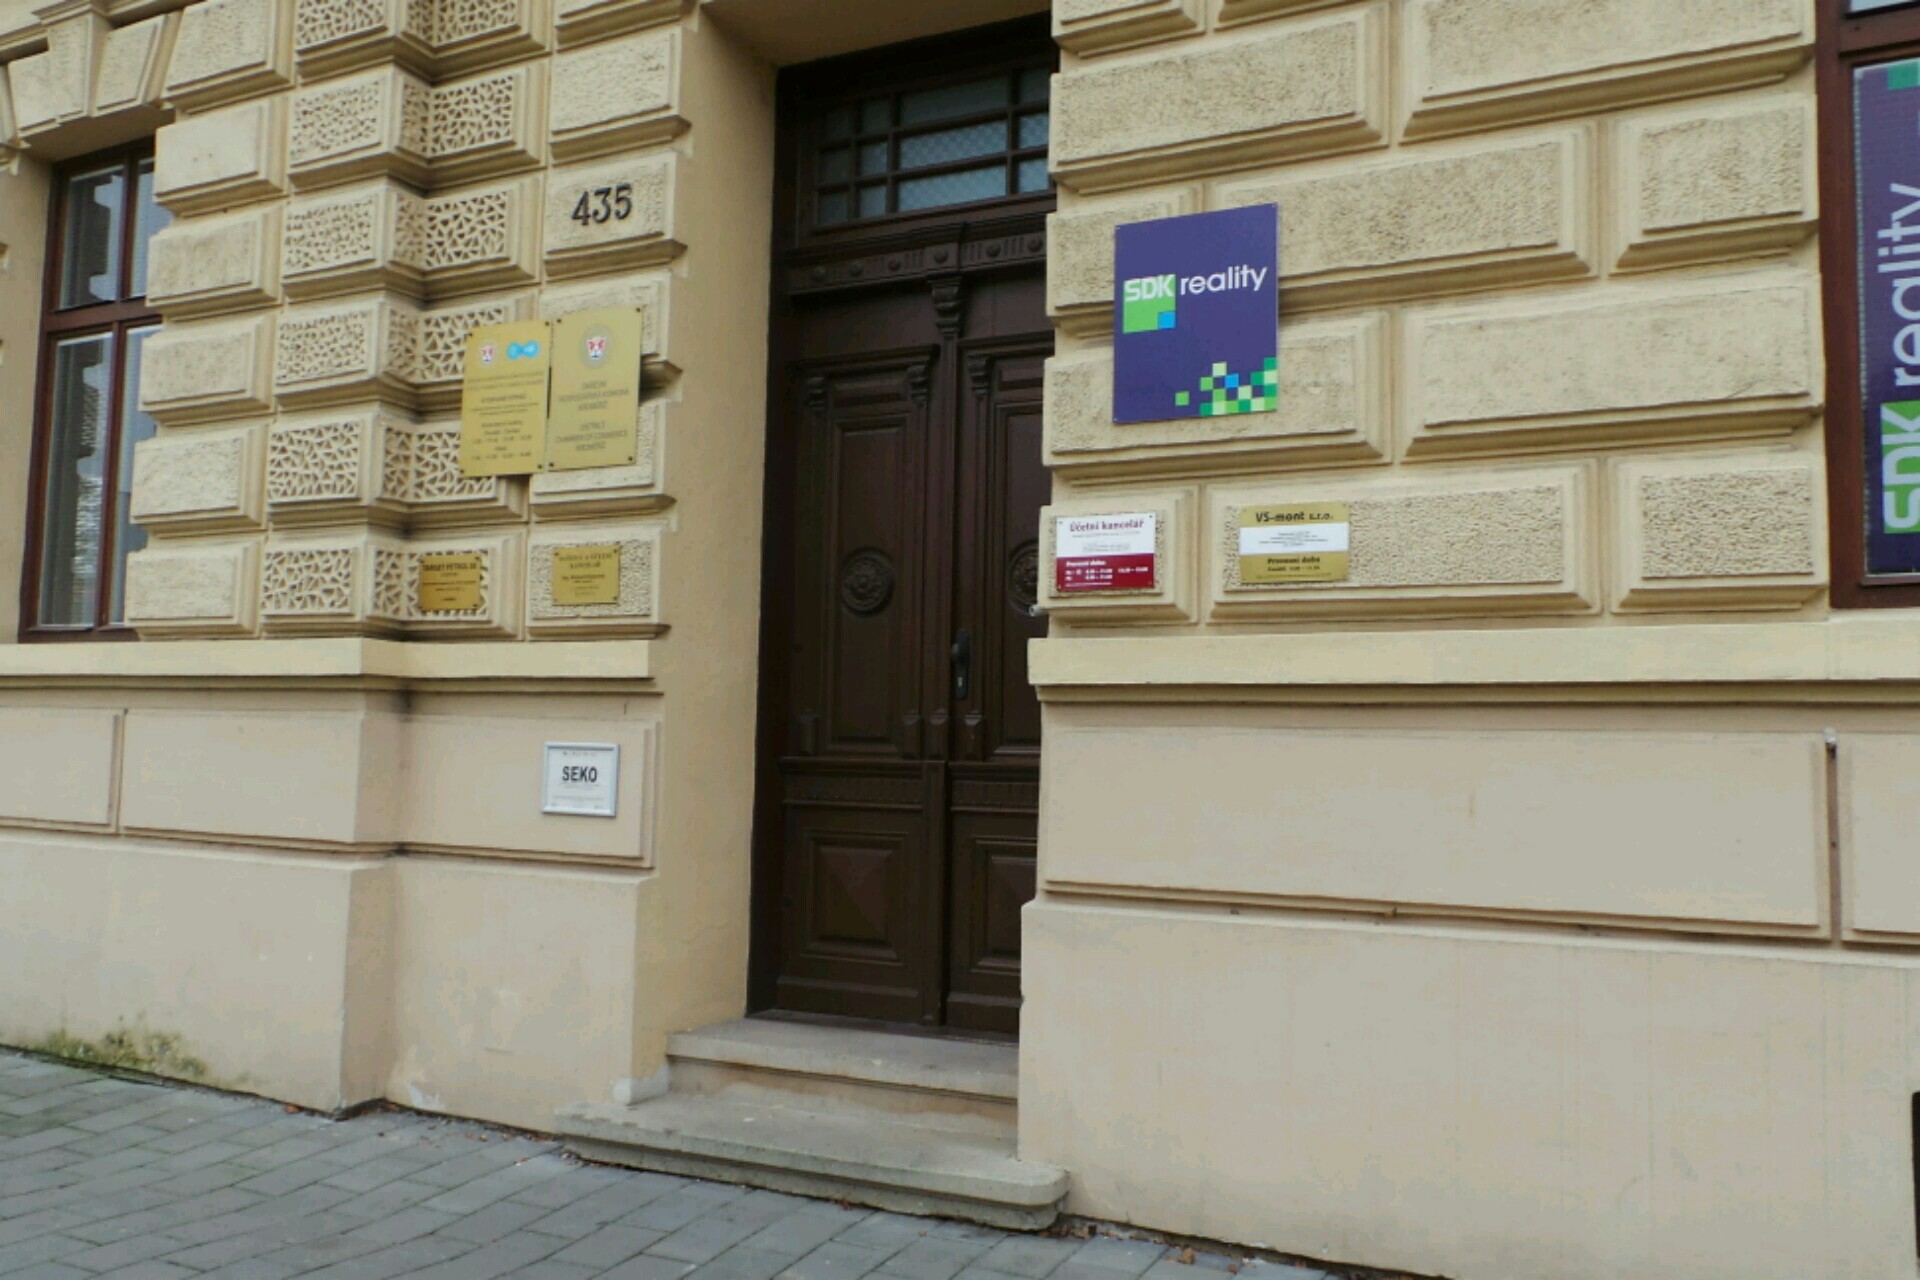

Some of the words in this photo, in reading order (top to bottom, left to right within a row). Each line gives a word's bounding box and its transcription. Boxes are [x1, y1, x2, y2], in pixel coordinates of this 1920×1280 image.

[571, 183, 632, 226] 435
[1123, 273, 1176, 302] SDK
[1180, 264, 1268, 296] reality
[1069, 520, 1099, 532] Účetní
[1102, 518, 1145, 530] kancelář
[562, 765, 598, 783] SEKO
